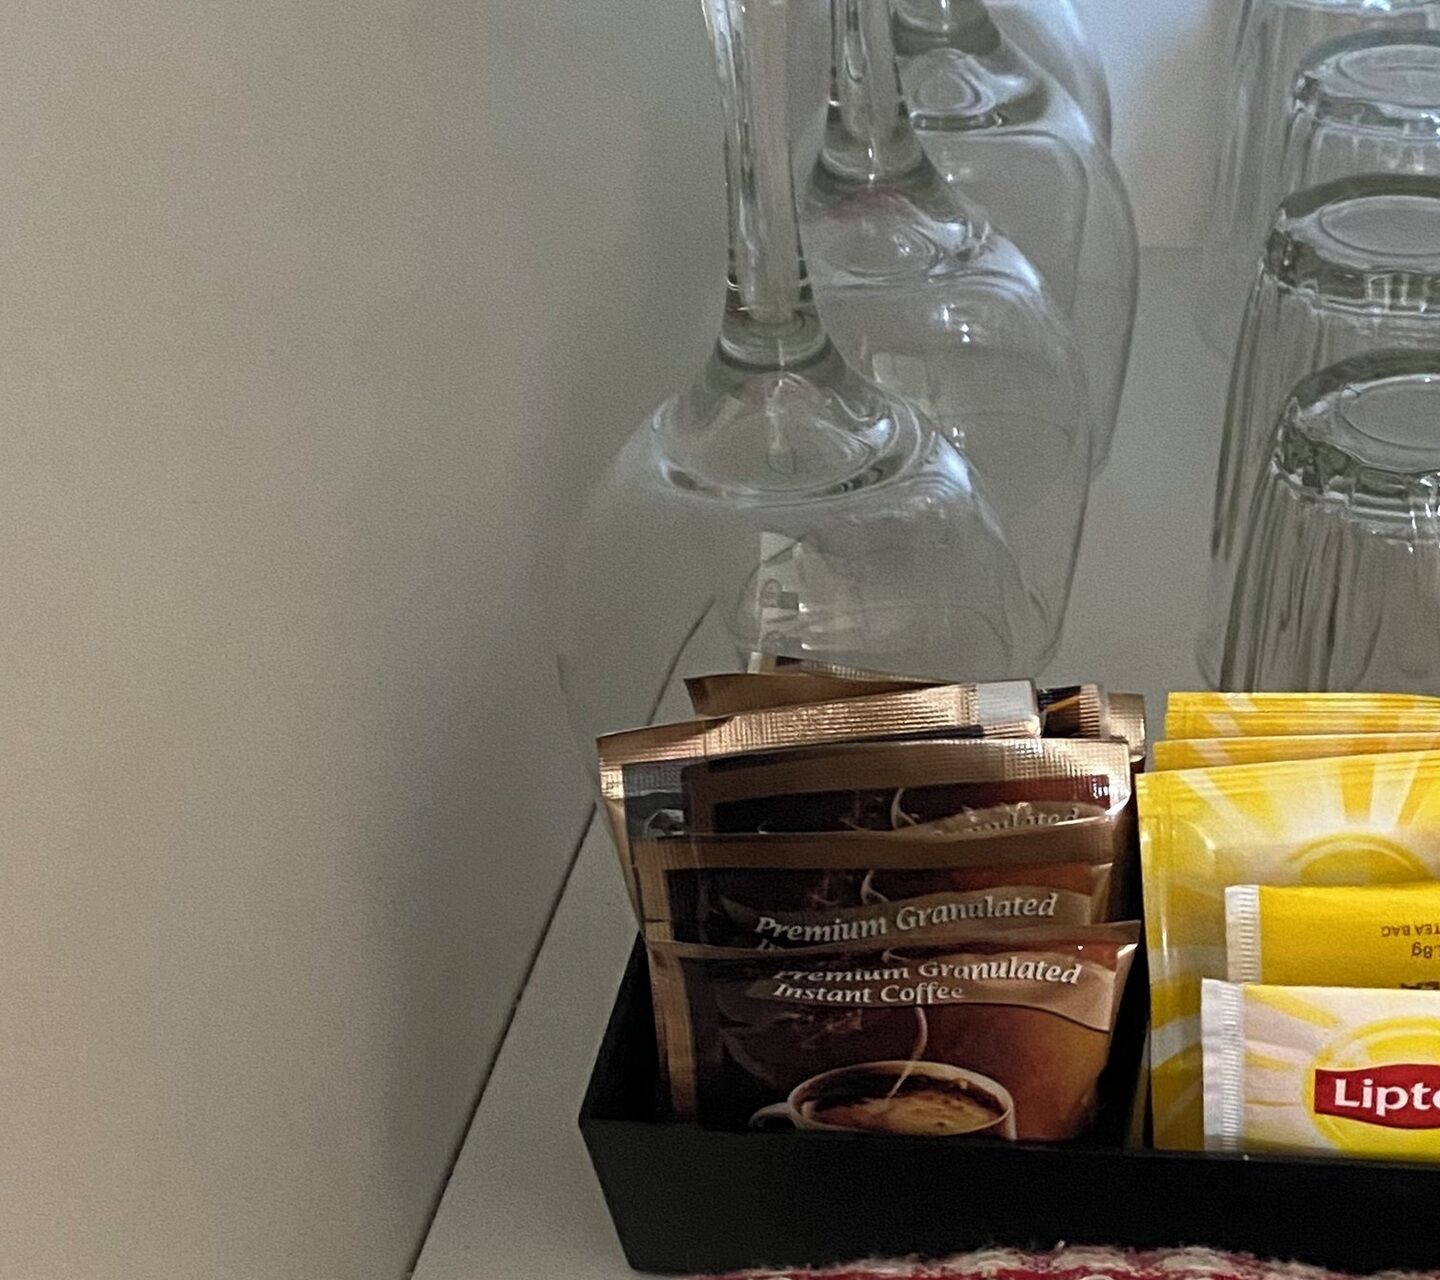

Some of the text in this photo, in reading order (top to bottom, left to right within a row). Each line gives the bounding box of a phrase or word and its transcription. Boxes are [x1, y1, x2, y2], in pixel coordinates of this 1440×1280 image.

[755, 892, 1059, 942] Premium Granulated
[1381, 925, 1411, 938] BAG
[917, 957, 1083, 986] Granulated
[773, 980, 966, 1005] Instant Coffee
